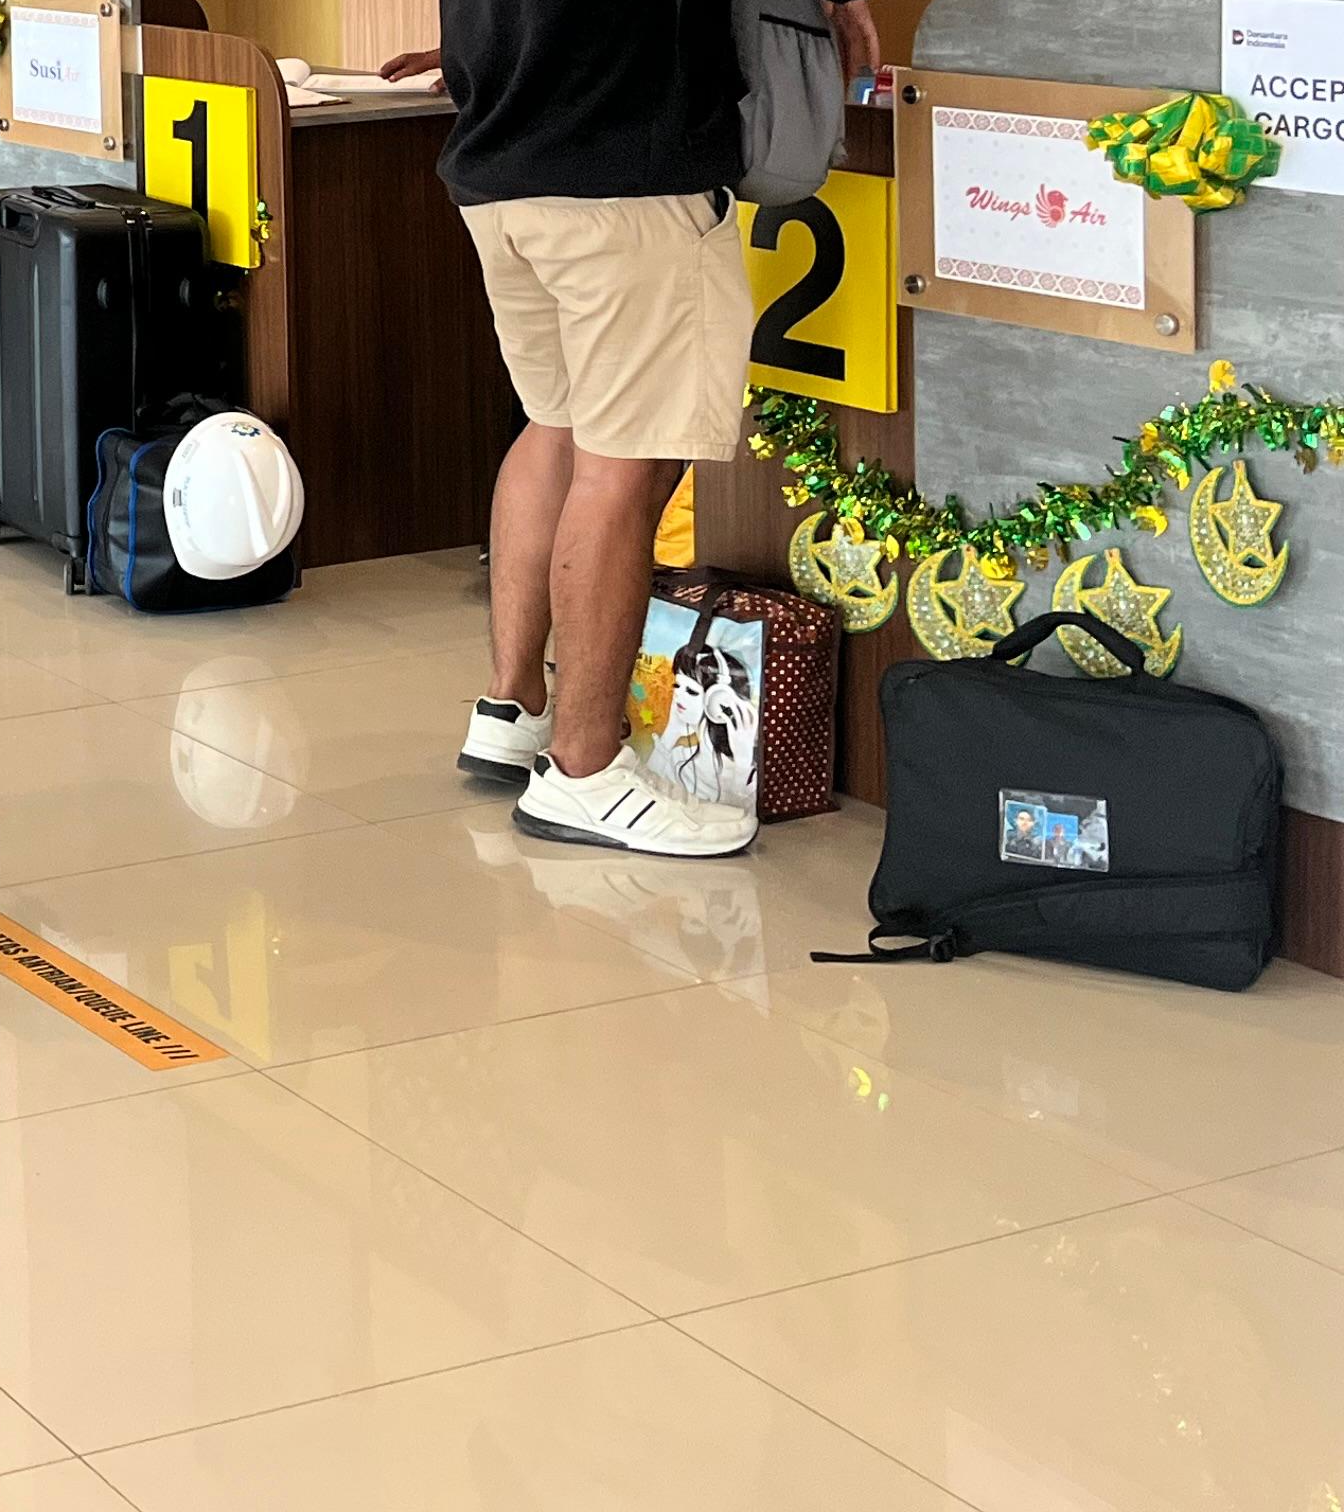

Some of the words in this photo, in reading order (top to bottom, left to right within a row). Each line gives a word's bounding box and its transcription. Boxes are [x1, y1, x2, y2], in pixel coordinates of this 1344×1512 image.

[29, 58, 62, 80] Susi
[1250, 74, 1344, 102] ACCEP
[172, 99, 208, 224] 1
[966, 187, 1032, 221] Wings
[1069, 201, 1107, 226] Air
[750, 196, 846, 382] 2
[120, 1021, 171, 1044] LINE
